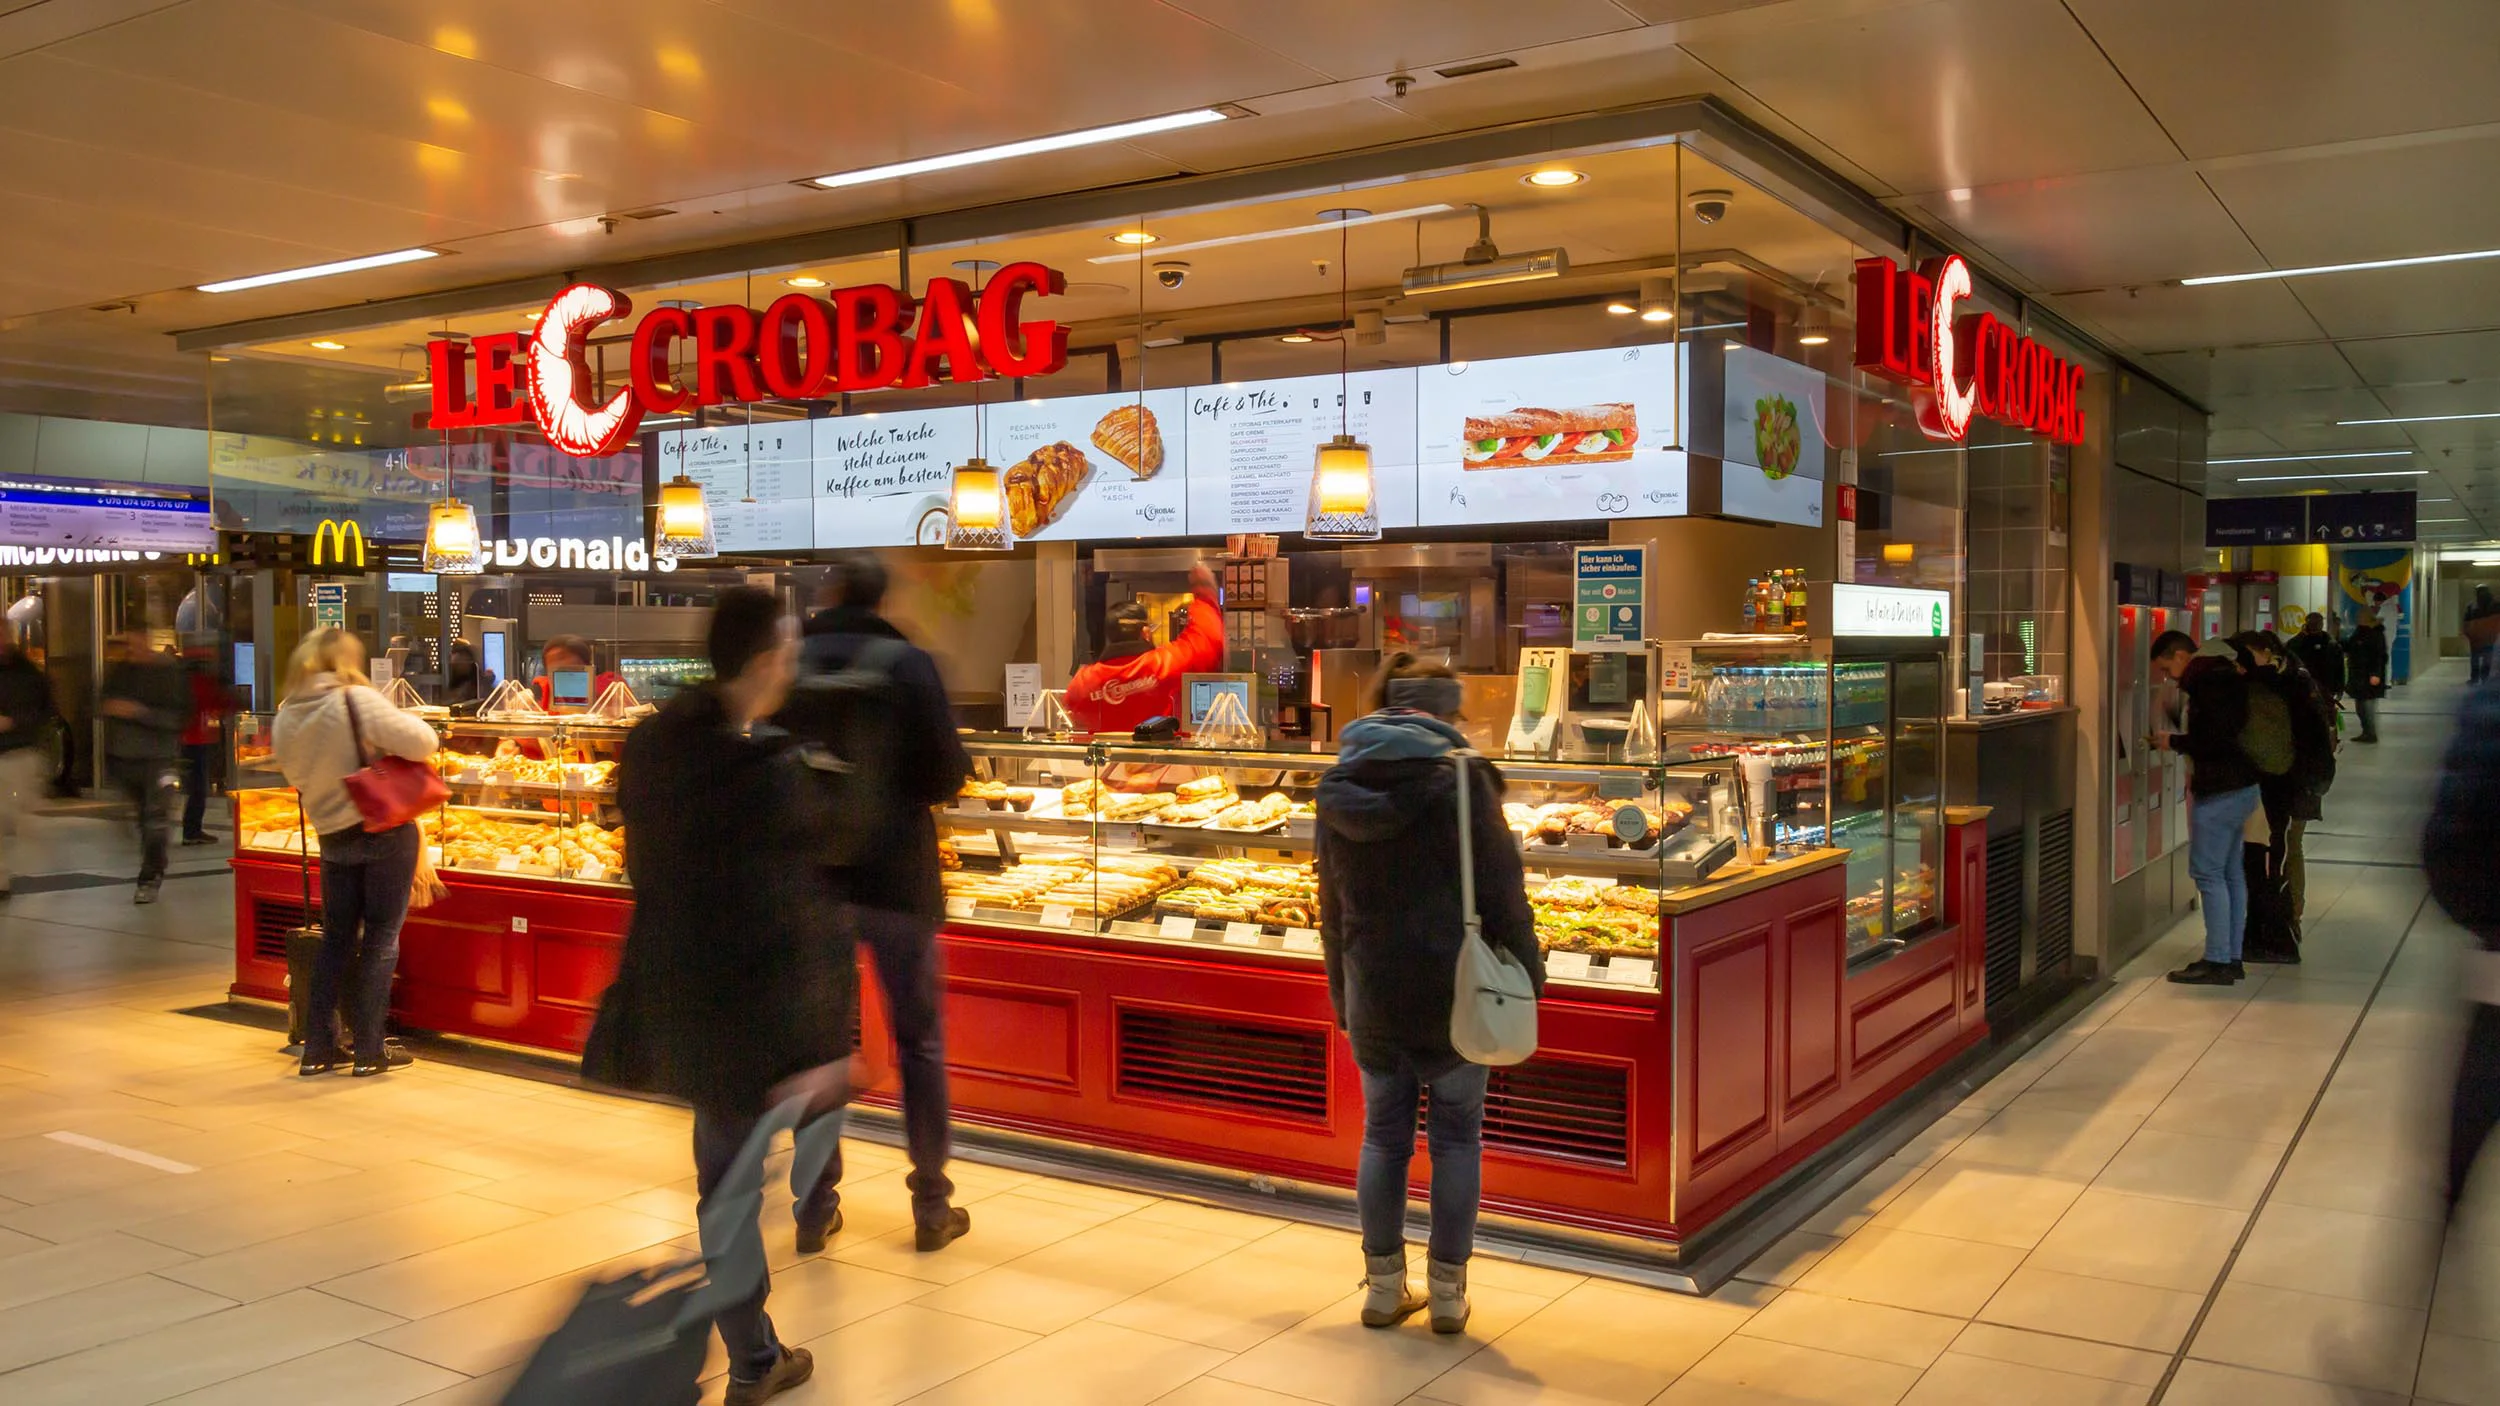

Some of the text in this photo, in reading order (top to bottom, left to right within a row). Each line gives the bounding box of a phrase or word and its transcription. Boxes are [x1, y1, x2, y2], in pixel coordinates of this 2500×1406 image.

[428, 261, 1068, 430] LE CROBAG
[1858, 257, 2086, 446] LE CROBAG
[1194, 389, 1280, 420] Café & Thé
[663, 440, 688, 459] Café
[700, 436, 720, 450] Thé
[837, 422, 936, 452] Welche Tasche
[1009, 432, 1041, 441] TASCHE
[843, 449, 929, 472] steht deinem
[826, 461, 952, 499] Kaffee am besten?
[105, 497, 122, 505] U70
[140, 500, 156, 508] U75
[157, 501, 173, 509] U76
[174, 501, 189, 509] U77
[129, 511, 136, 520] 3
[1581, 554, 1624, 564] Hier kann ich
[1581, 563, 1637, 573] sicher einkaufen:
[1090, 690, 1104, 702] LE
